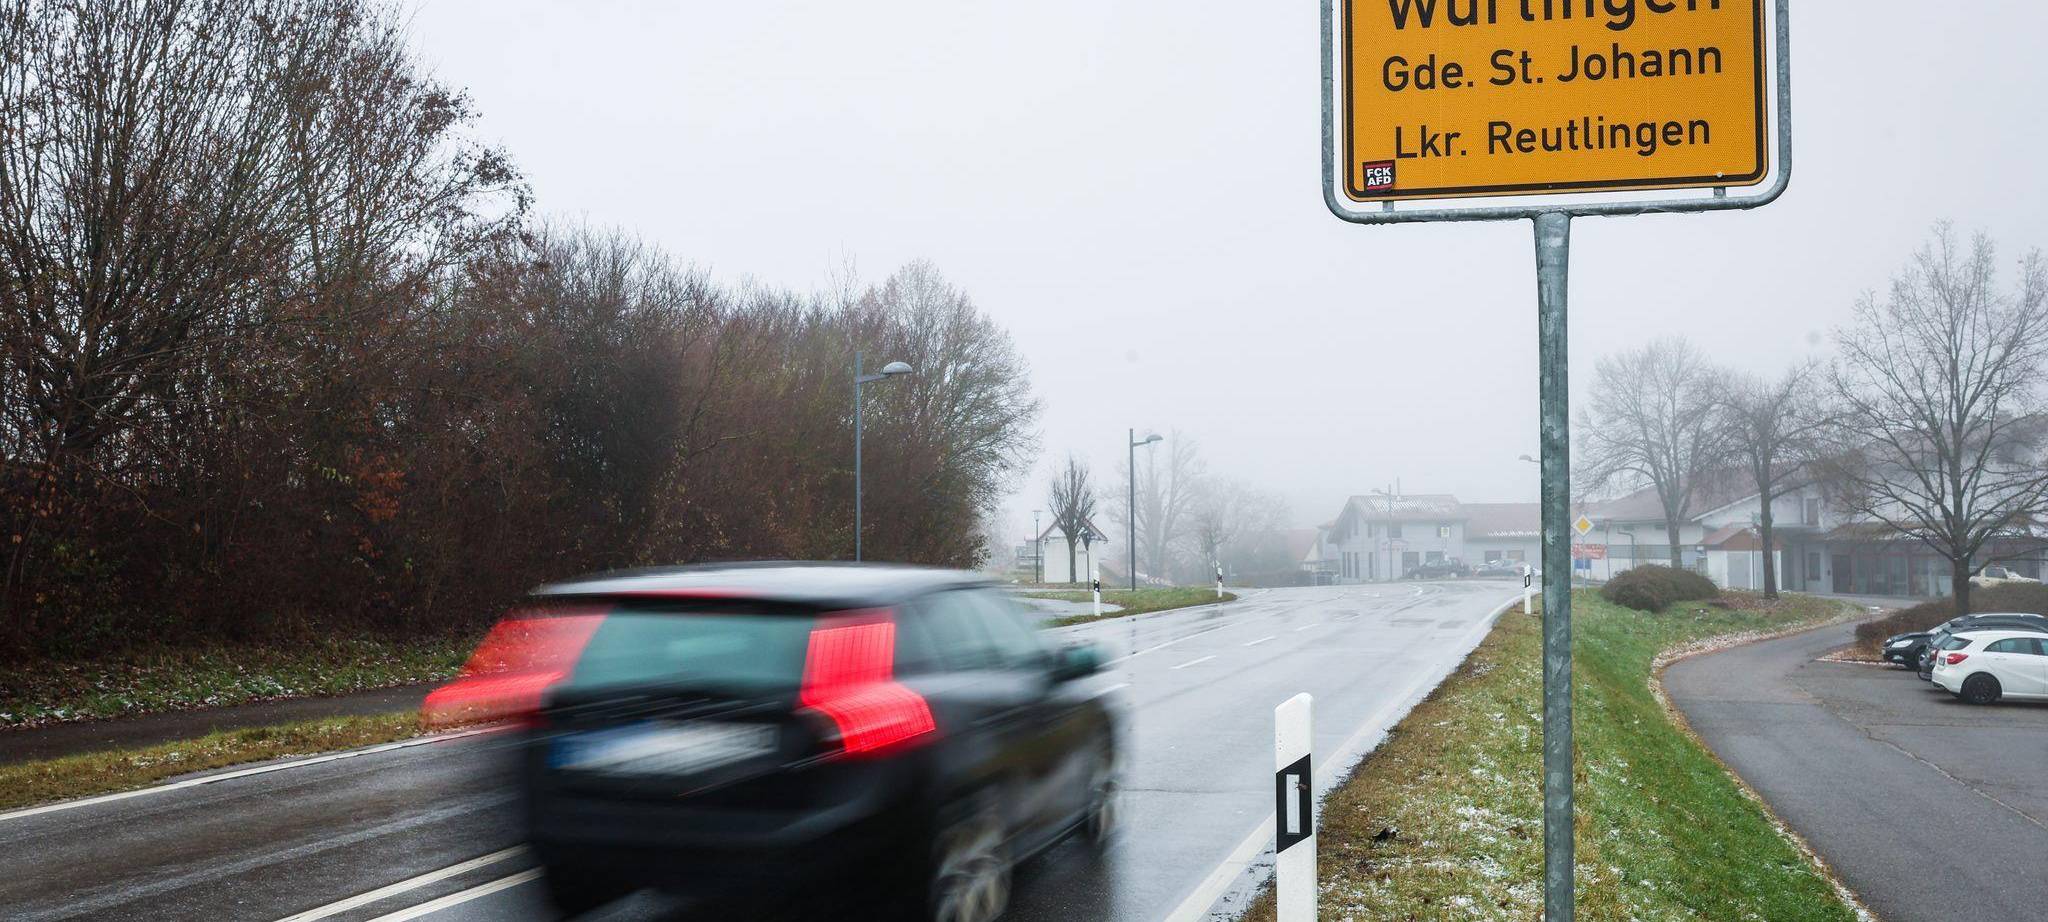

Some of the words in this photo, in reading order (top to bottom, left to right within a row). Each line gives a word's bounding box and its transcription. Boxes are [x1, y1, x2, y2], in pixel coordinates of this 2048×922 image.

[1382, 53, 1474, 92] Gde.
[1488, 48, 1544, 87] St.
[1556, 42, 1722, 83] Johann
[1395, 124, 1467, 159] Lkr.
[1487, 115, 1710, 157] Reutlingen
[1366, 167, 1391, 178] FCK
[1367, 175, 1392, 187] AFD
